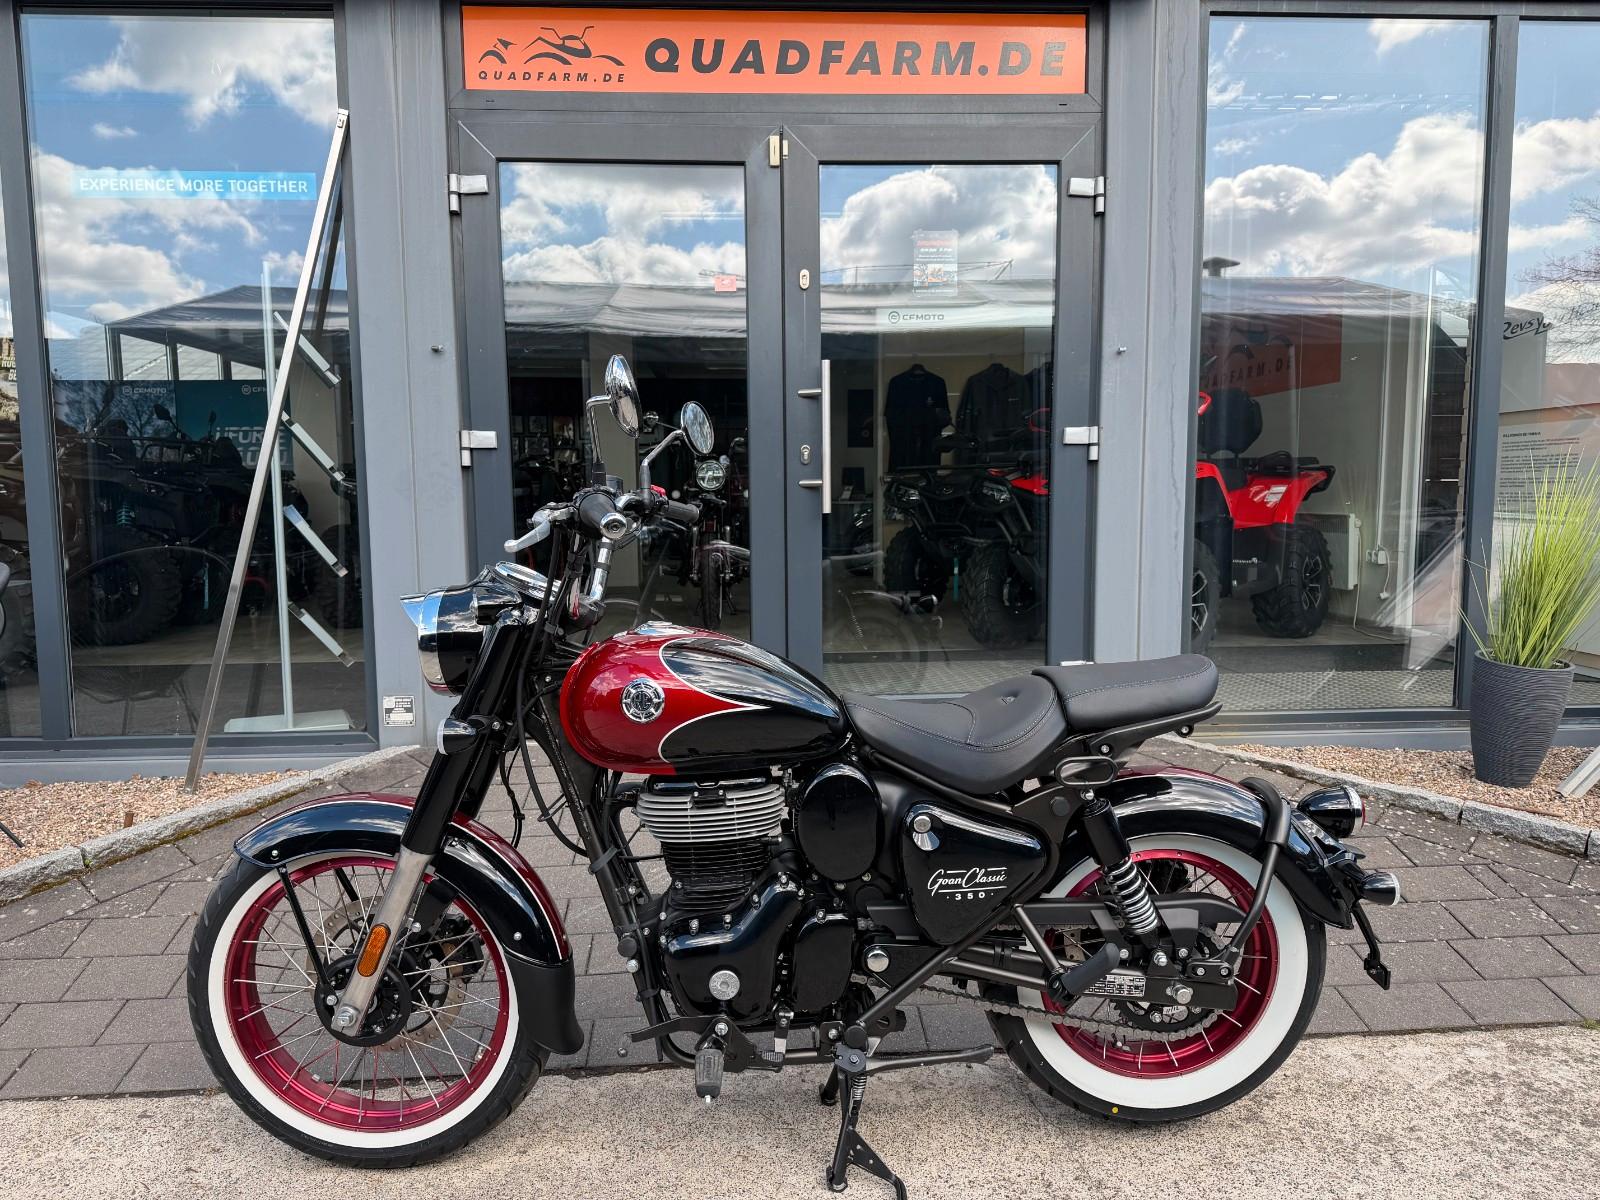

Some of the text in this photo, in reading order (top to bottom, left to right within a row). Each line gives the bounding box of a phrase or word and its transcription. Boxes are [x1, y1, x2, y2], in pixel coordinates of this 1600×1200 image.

[644, 37, 1067, 76] QUADFARM.DE
[478, 70, 625, 83] QUADFARM.DE
[79, 178, 308, 193] EXPERIENCE MORE TOGETHER
[902, 313, 945, 321] CFMOTO
[927, 867, 1008, 897] Goan Classic
